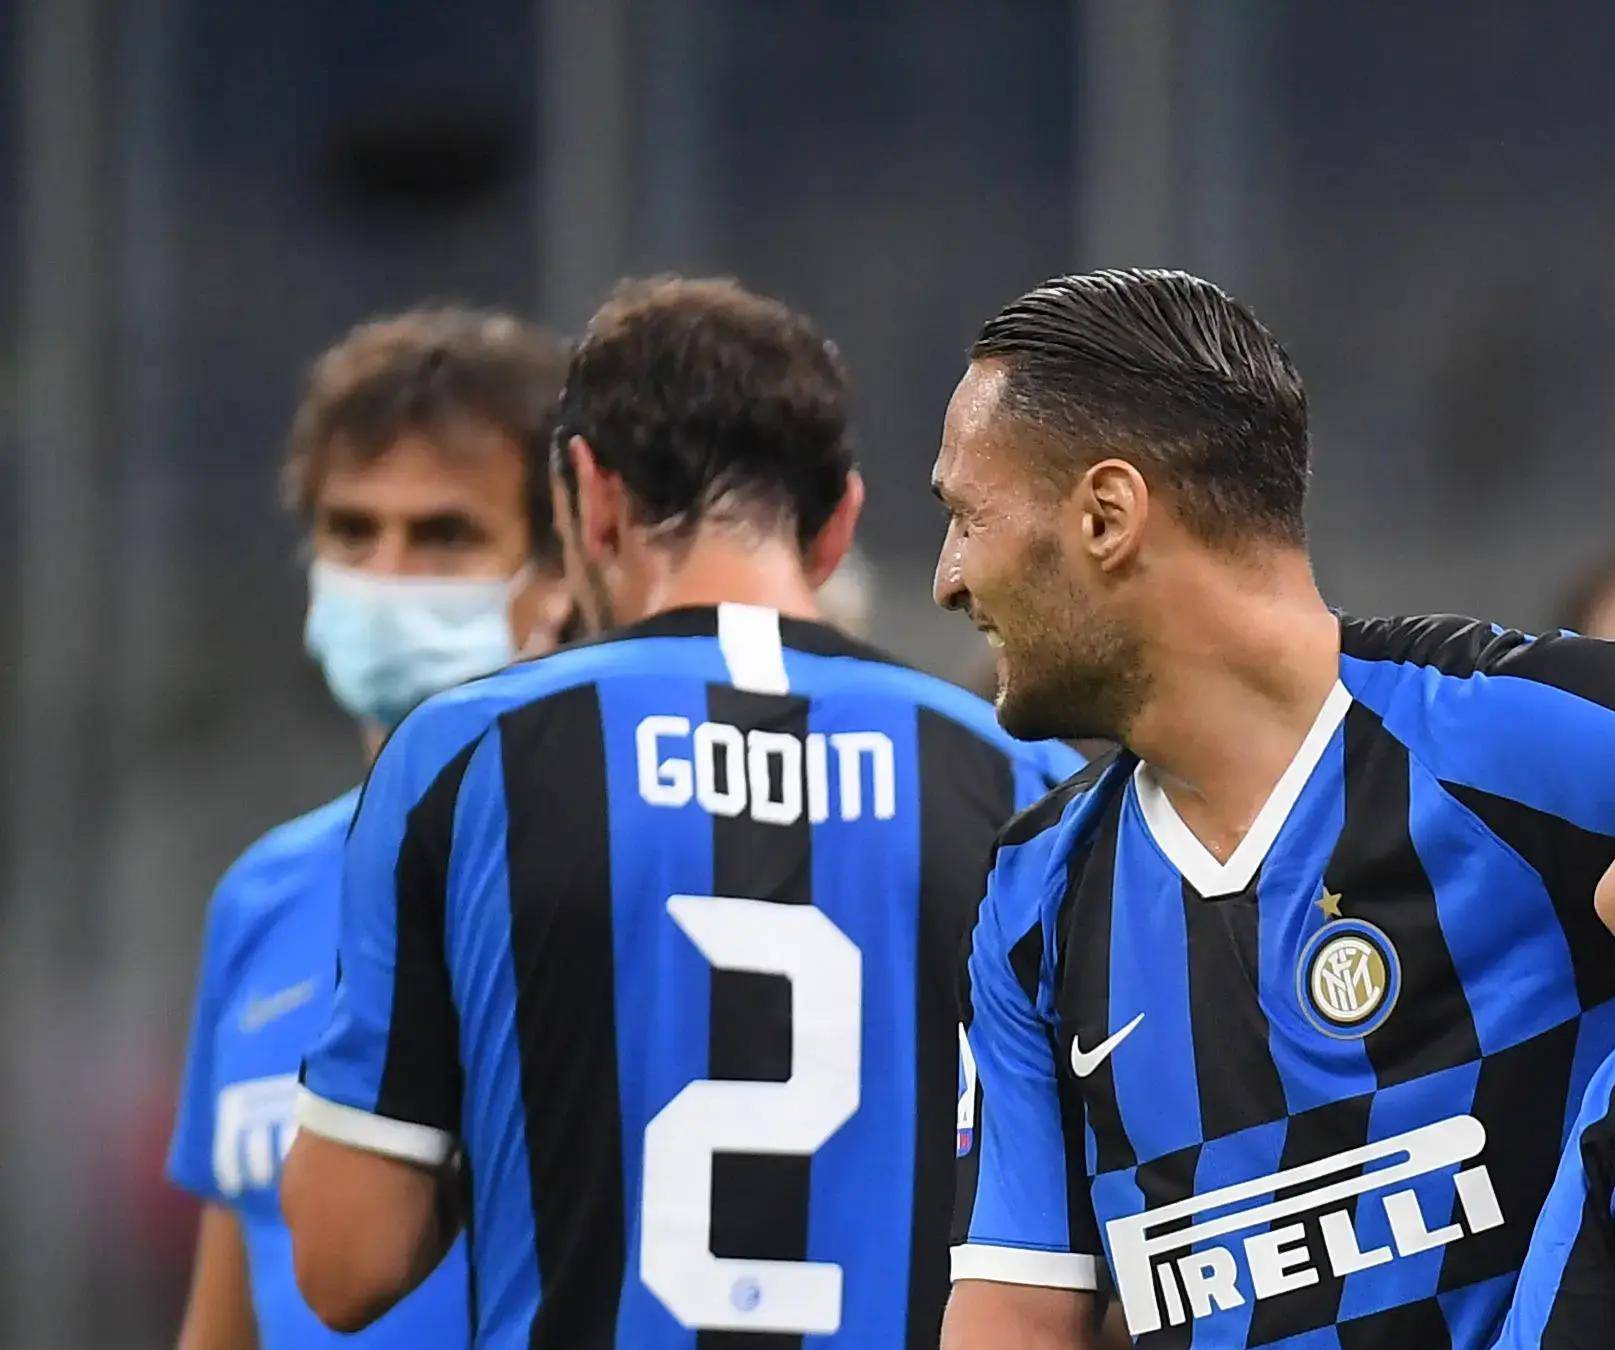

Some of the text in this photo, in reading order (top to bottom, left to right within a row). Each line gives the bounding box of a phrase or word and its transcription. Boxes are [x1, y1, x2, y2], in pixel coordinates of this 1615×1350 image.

[636, 715, 895, 826] GODIN
[639, 894, 862, 1335] 2
[1106, 1114, 1505, 1337] PIRELLI
